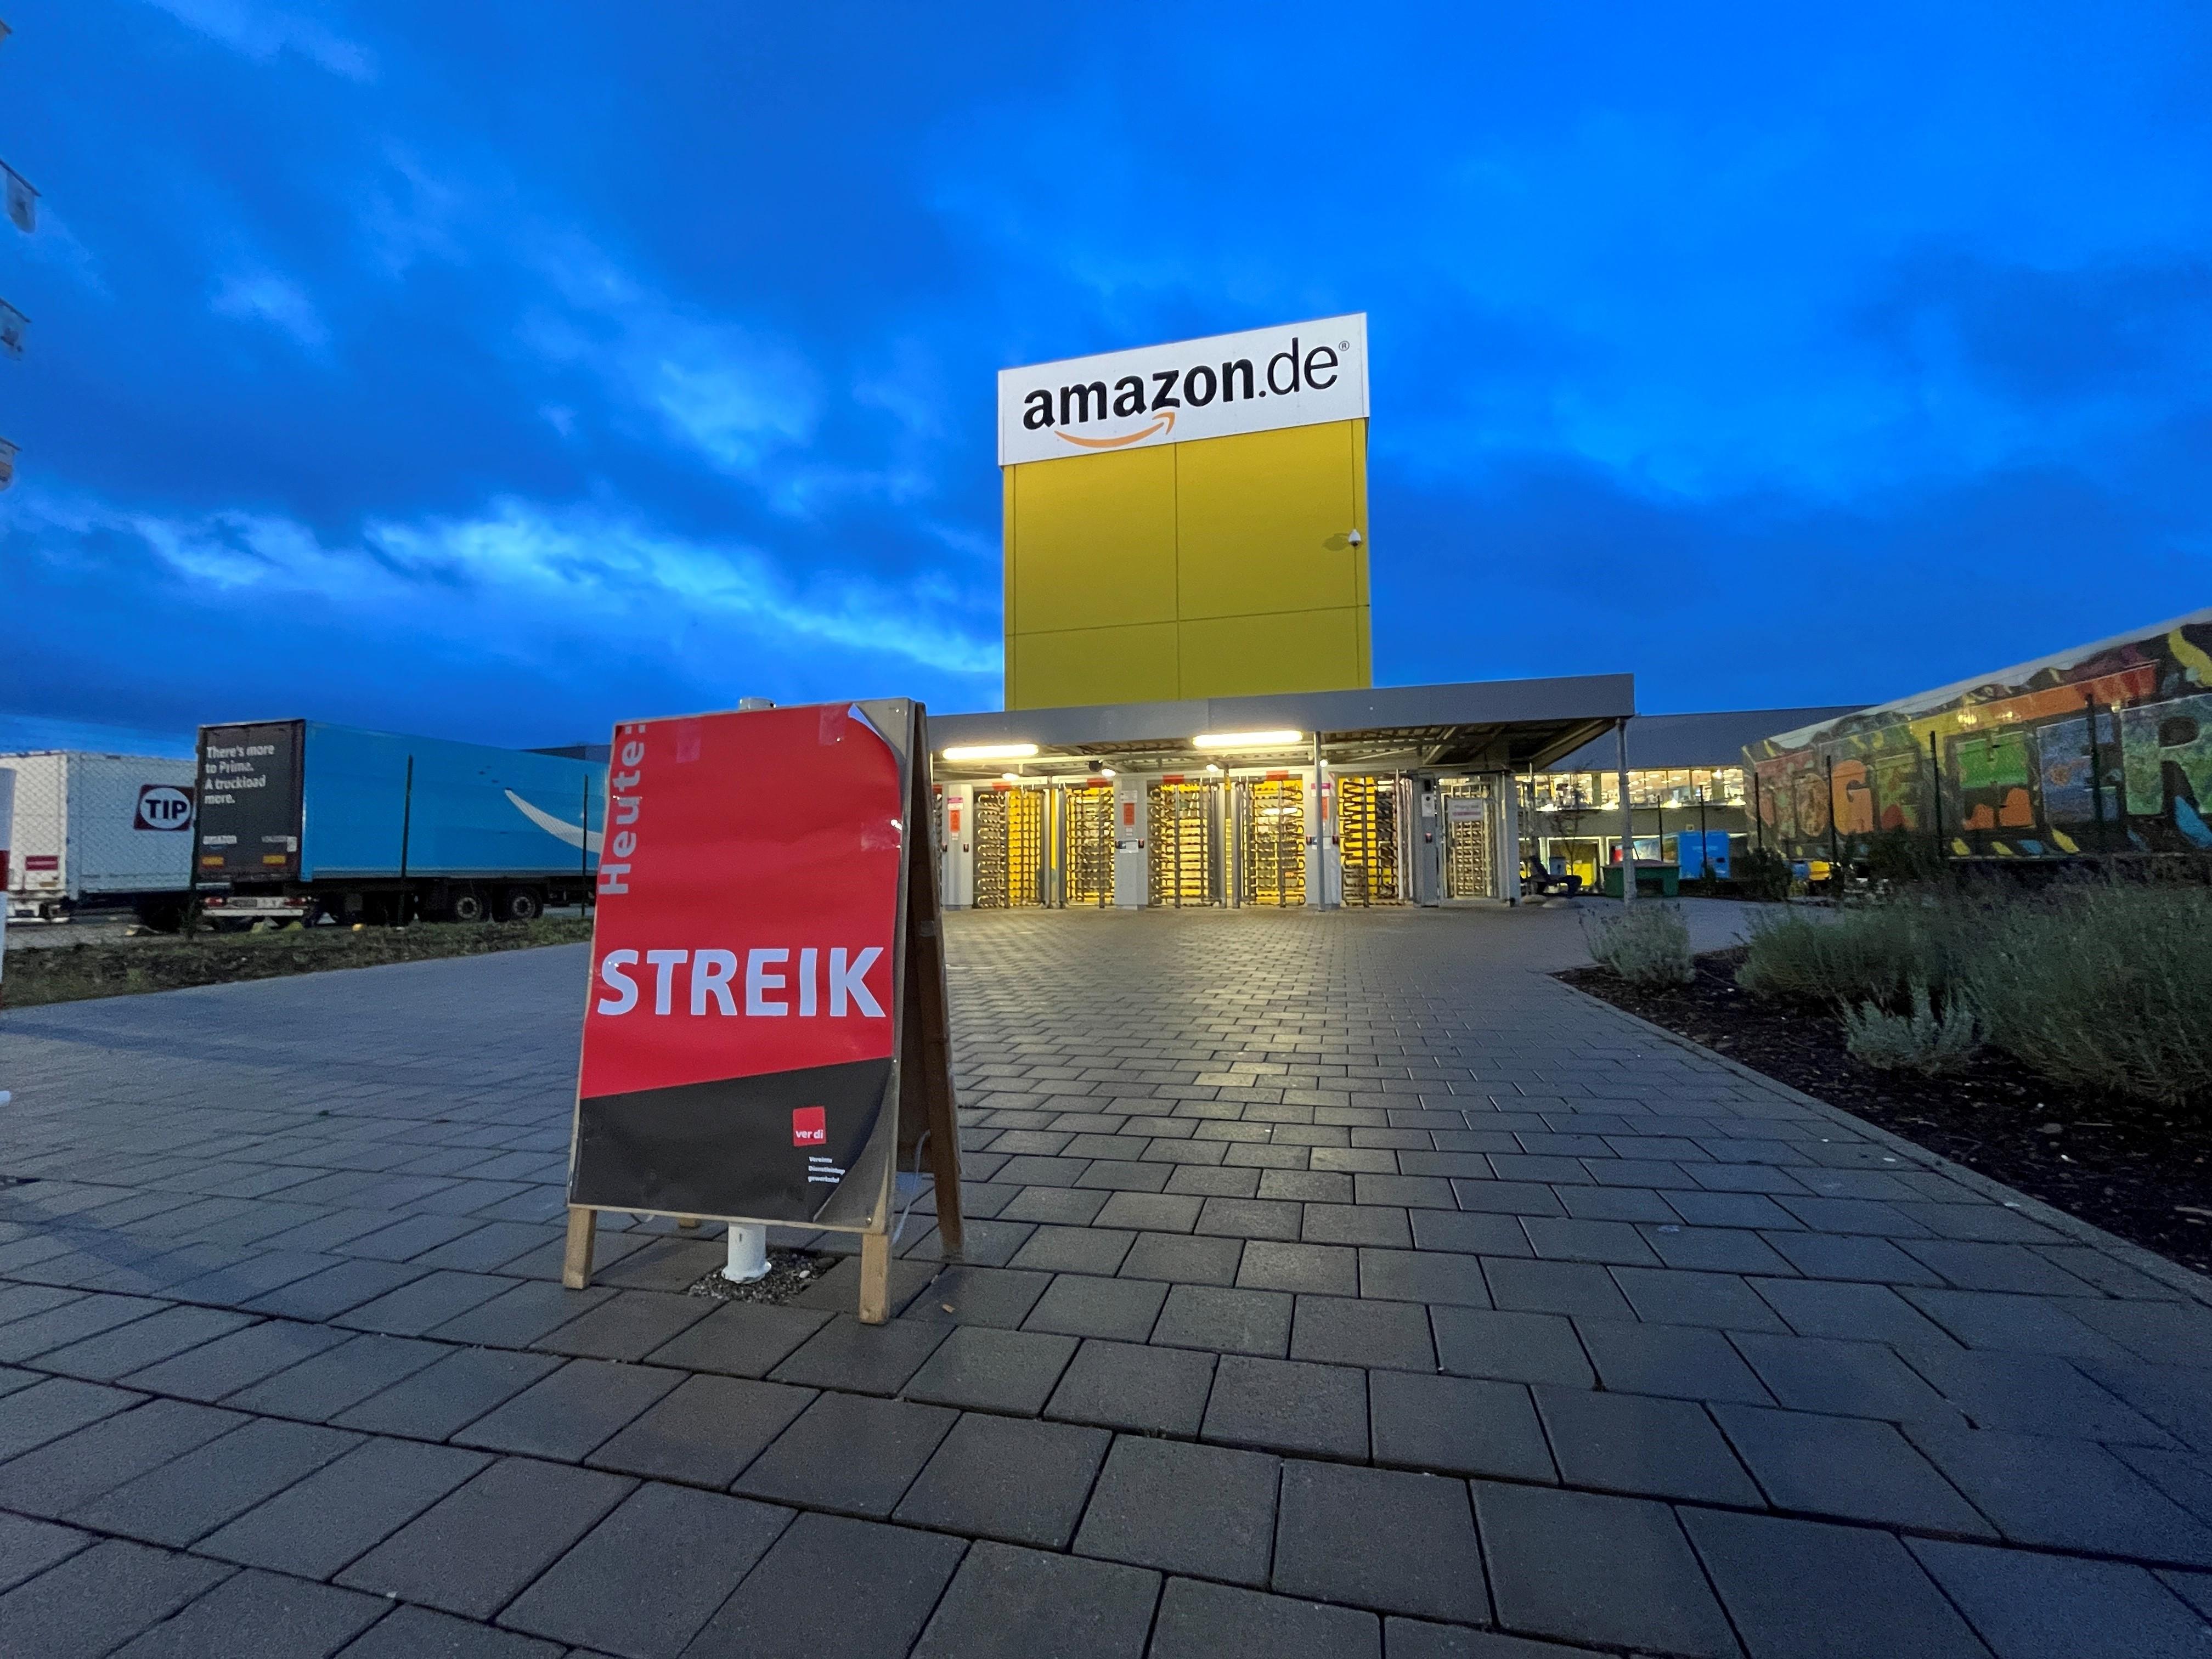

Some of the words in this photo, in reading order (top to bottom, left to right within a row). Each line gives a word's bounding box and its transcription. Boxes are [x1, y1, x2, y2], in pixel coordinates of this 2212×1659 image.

[246, 744, 275, 756] more
[205, 762, 217, 774] to
[204, 777, 213, 790] A
[145, 799, 188, 820] TIP
[599, 724, 646, 894] Heute:
[597, 947, 886, 1017] STREIK
